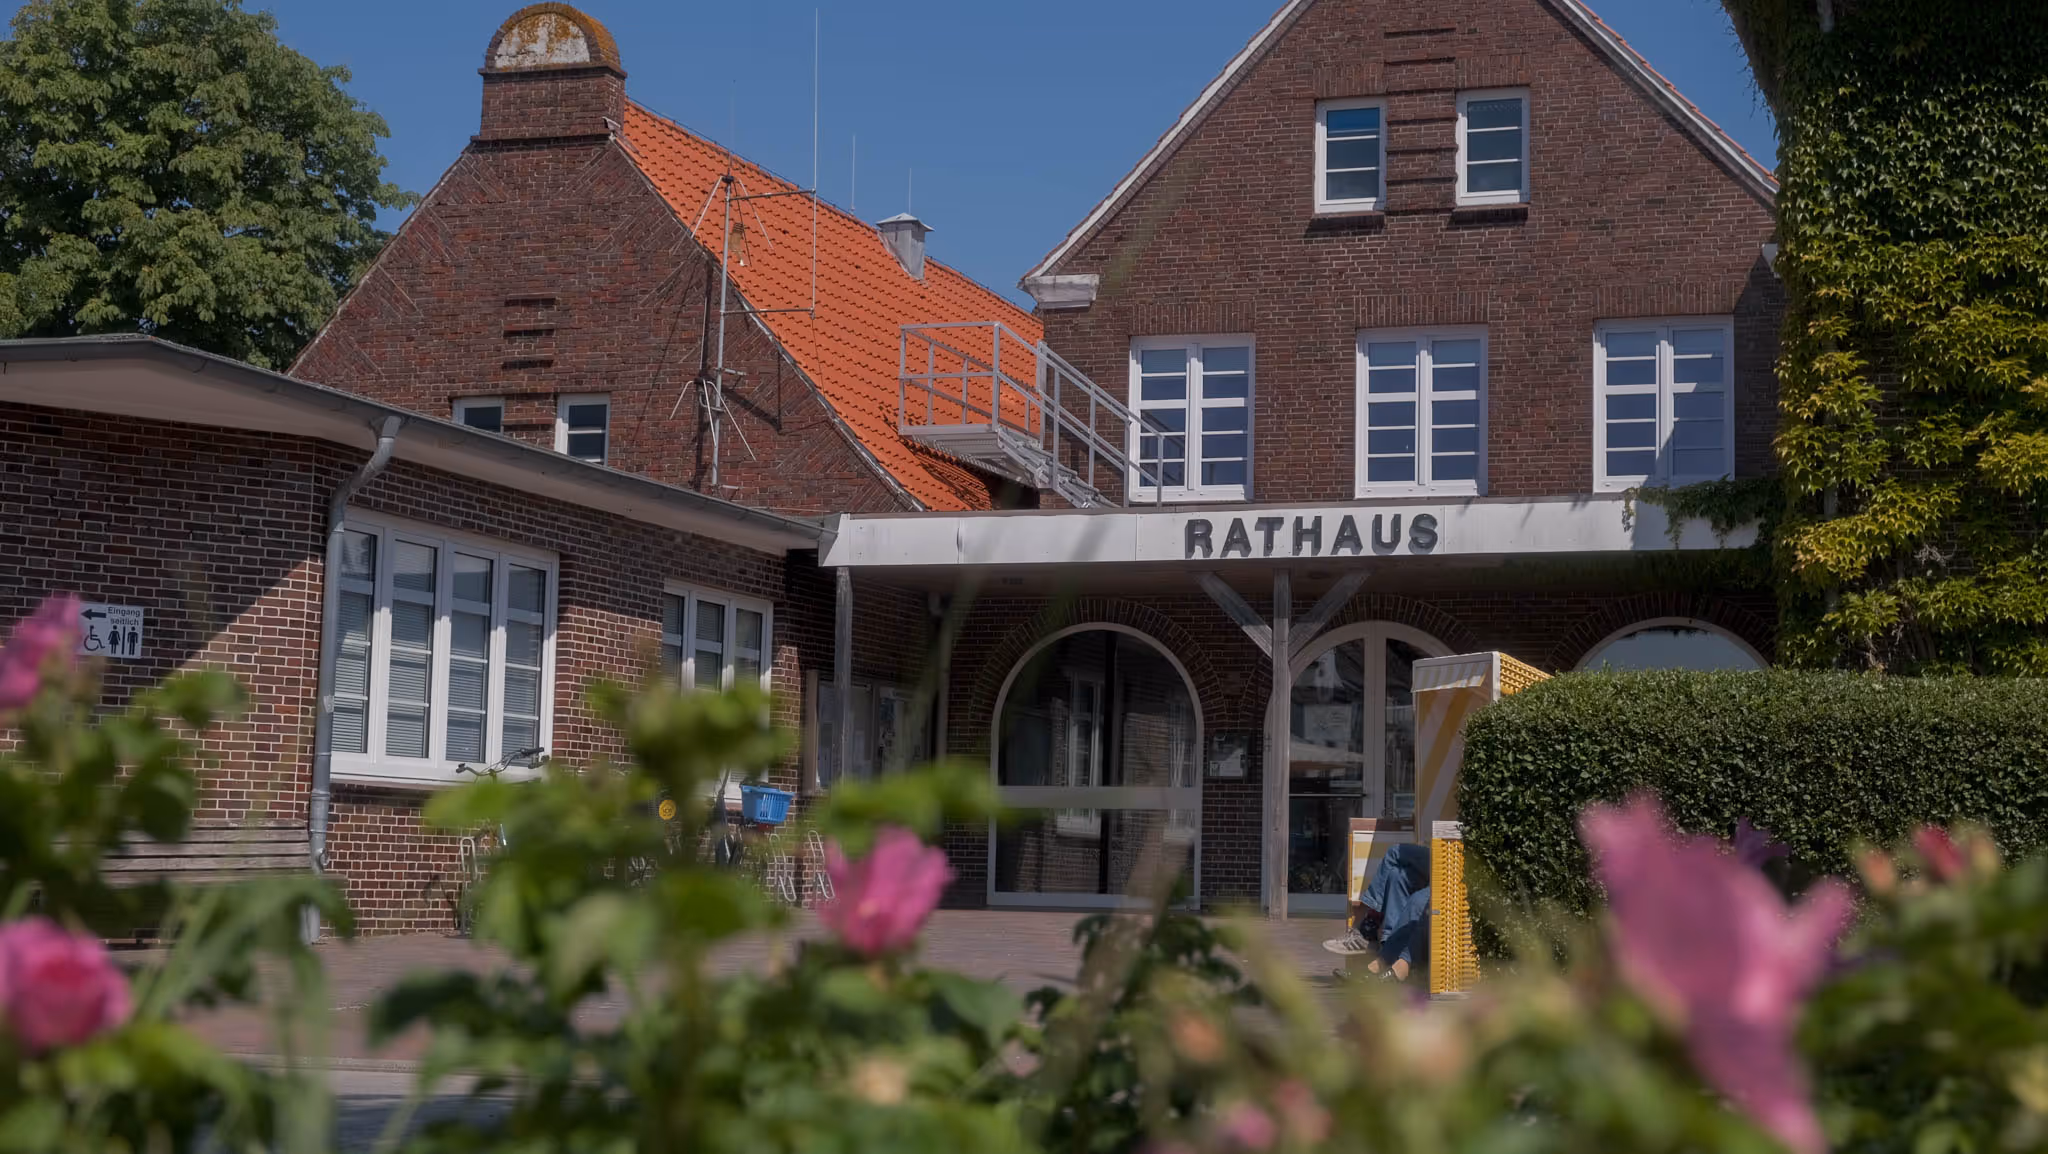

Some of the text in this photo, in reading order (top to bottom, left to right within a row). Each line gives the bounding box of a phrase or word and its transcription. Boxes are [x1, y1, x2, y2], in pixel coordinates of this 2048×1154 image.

[1184, 512, 1439, 559] RATHAUS
[107, 606, 141, 618] Eingang
[110, 618, 139, 626] seitlich
